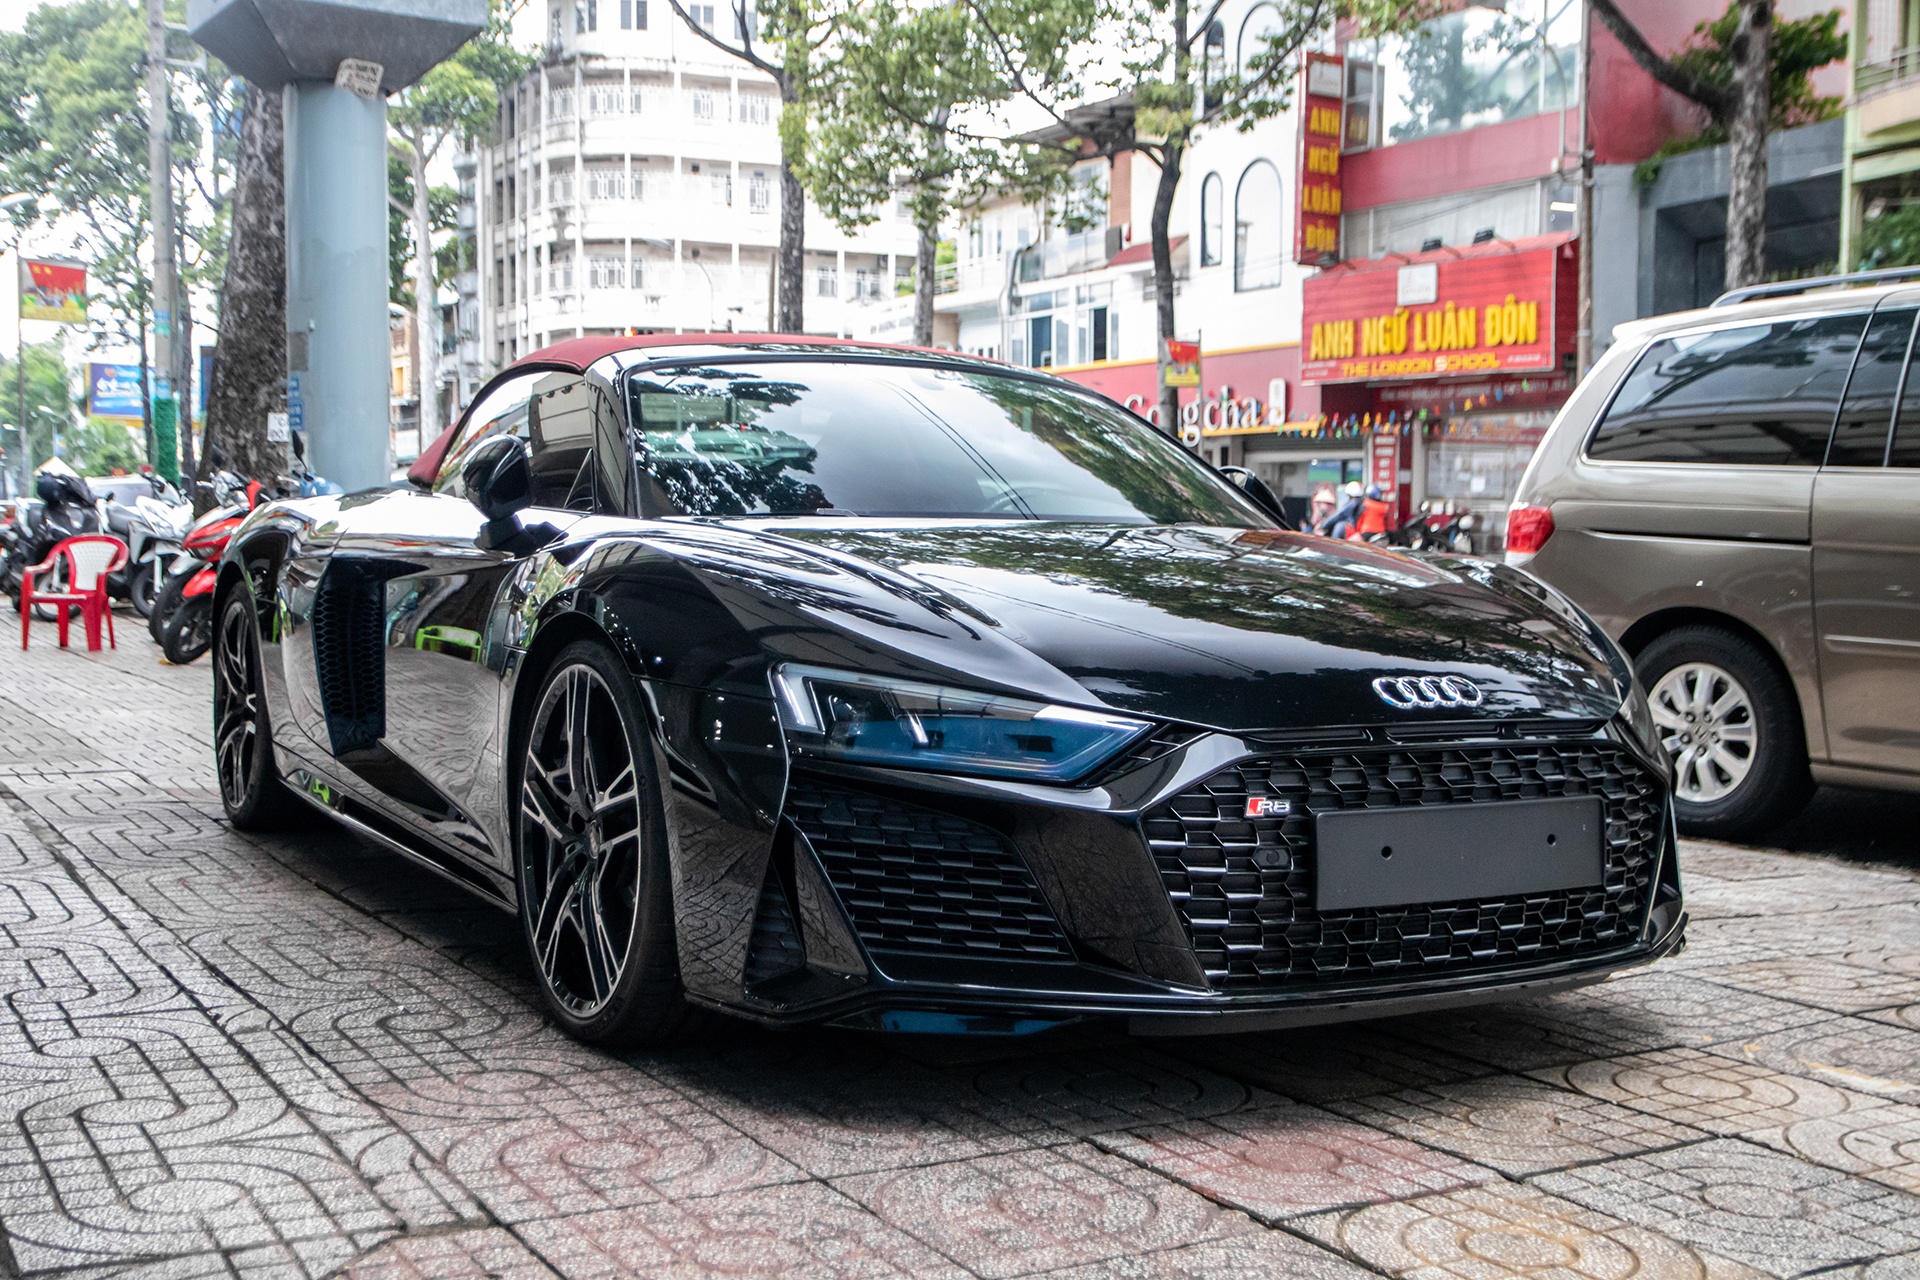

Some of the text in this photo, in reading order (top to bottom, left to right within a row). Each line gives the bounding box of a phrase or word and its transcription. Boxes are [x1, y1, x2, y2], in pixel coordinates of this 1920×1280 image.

[1309, 106, 1341, 136] ANH
[1302, 181, 1341, 216] LUÂN
[1309, 319, 1355, 361] ANH
[1413, 301, 1477, 352] LUÂN
[1484, 294, 1538, 348] ĐÔN
[1342, 363, 1369, 377] THE
[1372, 358, 1433, 377] LONDON
[1434, 352, 1501, 373] SCHOOL
[1257, 801, 1290, 813] R8
